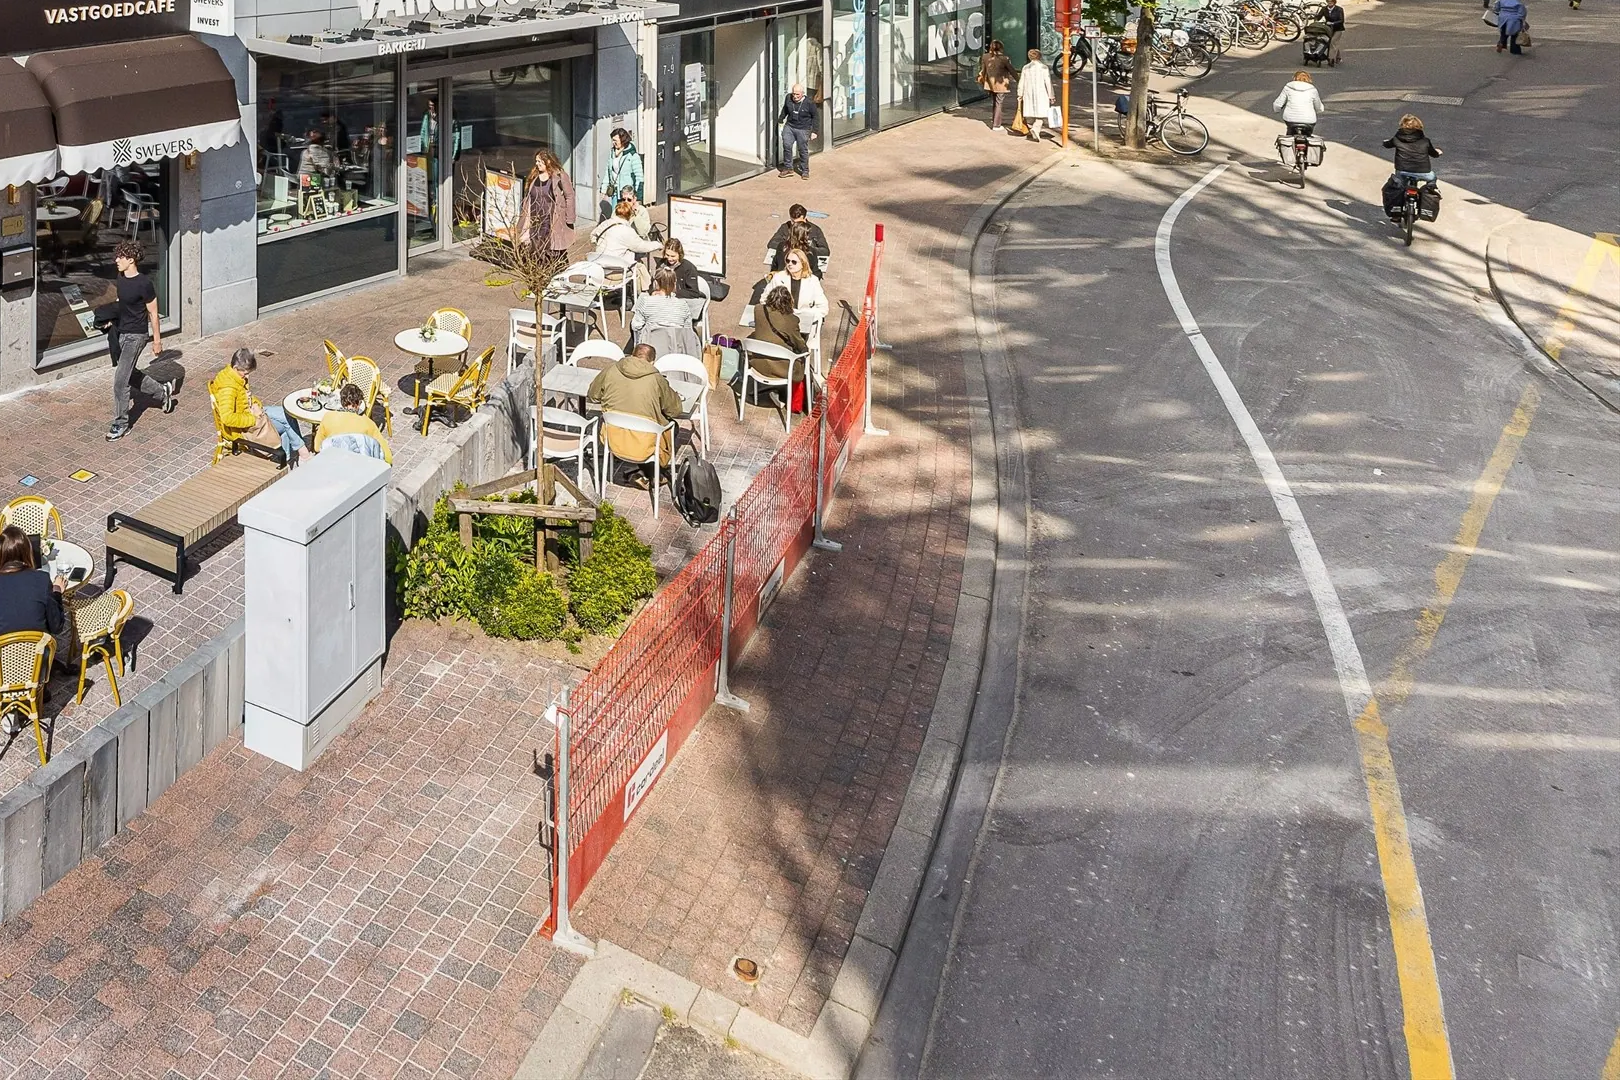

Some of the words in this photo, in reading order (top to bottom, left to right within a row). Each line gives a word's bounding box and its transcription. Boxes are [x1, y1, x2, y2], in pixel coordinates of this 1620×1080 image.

[197, 16, 220, 27] INVEST
[377, 38, 427, 57] BAKKERIJ
[927, 12, 986, 62] KBC
[134, 137, 194, 160] SWEVERS
